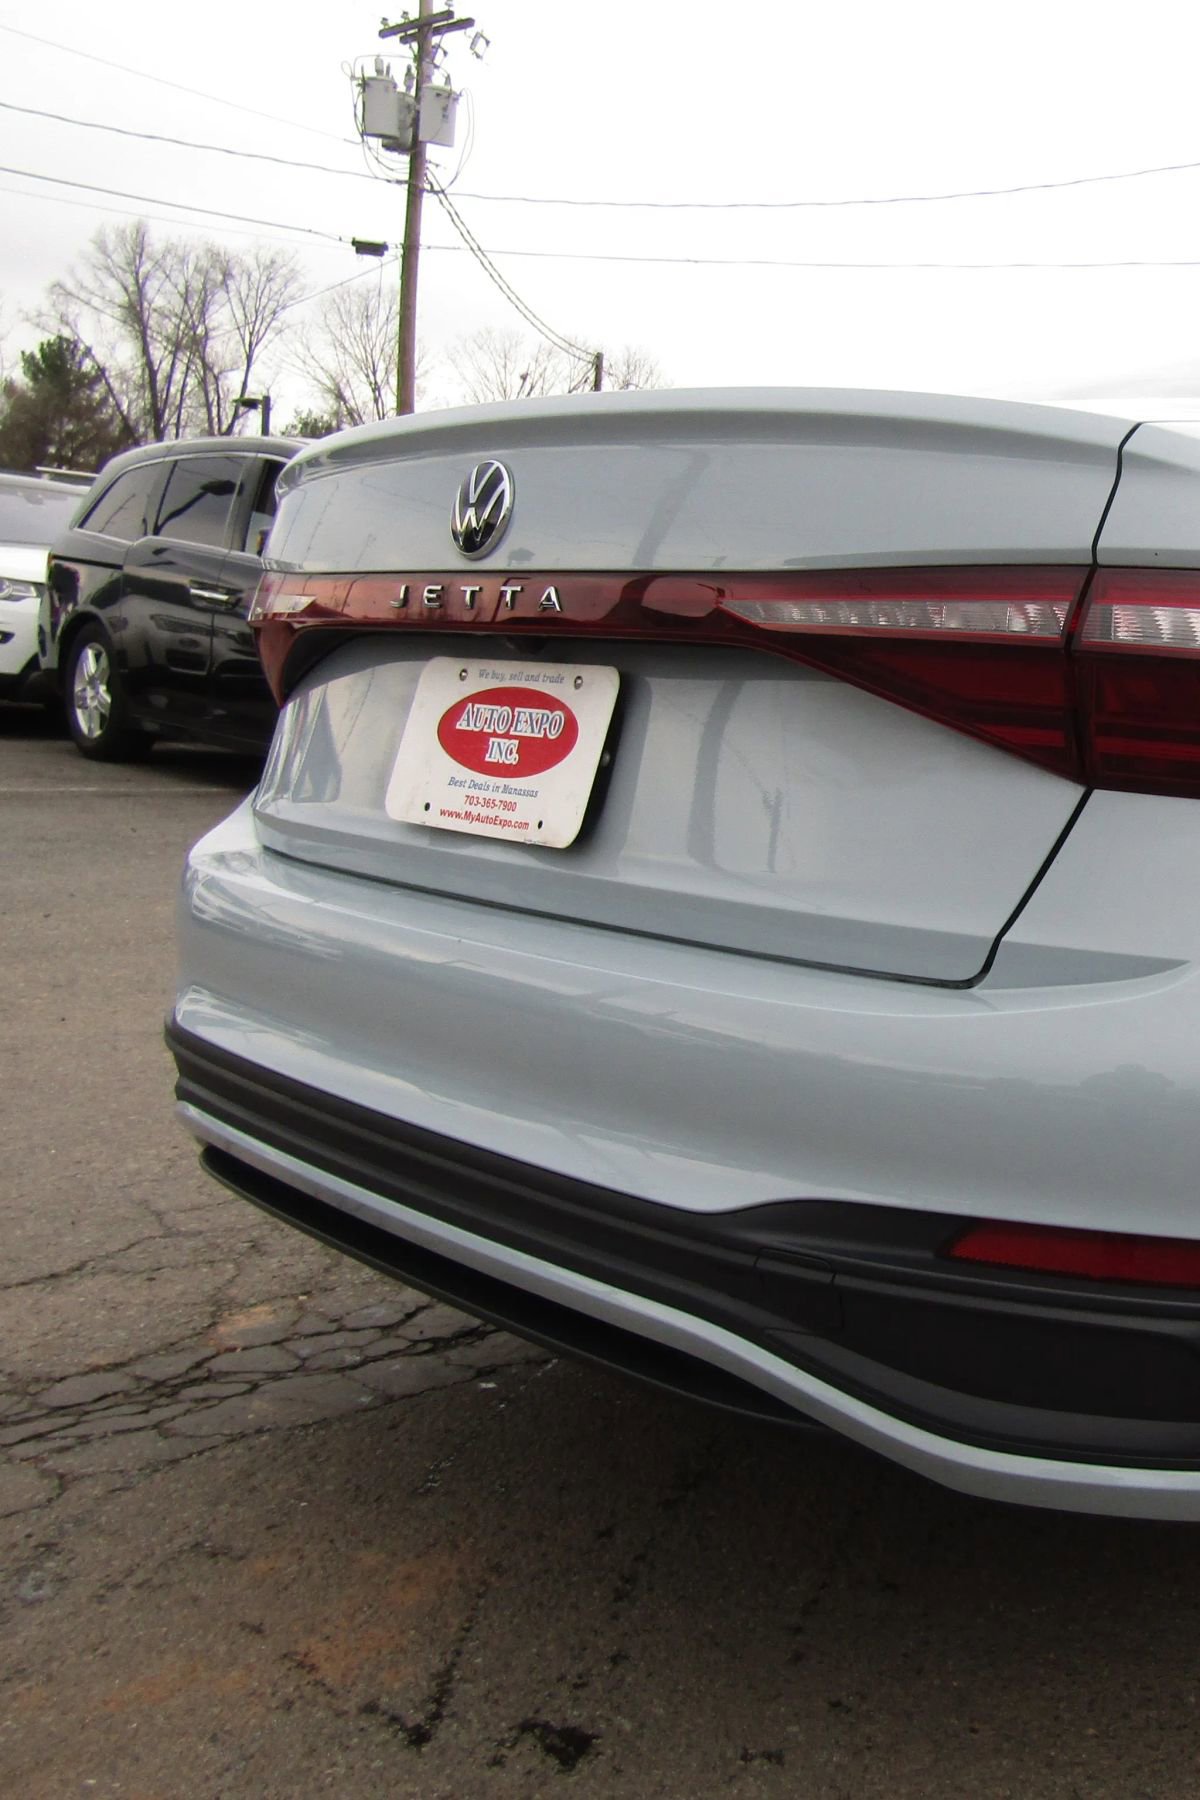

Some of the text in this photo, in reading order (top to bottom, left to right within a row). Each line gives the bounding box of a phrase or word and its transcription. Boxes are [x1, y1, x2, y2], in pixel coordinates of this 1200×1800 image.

[390, 584, 562, 612] JETTA
[479, 668, 489, 679] We
[509, 671, 523, 681] sell
[524, 672, 540, 682] and
[542, 672, 565, 684] trade
[457, 703, 564, 739] AUTO EXPO
[486, 739, 519, 765] INC.
[448, 776, 540, 798] Best Deals in Manassas
[464, 794, 517, 812] 703-365-7900
[439, 808, 530, 831] www.MyAutoExpo.com
